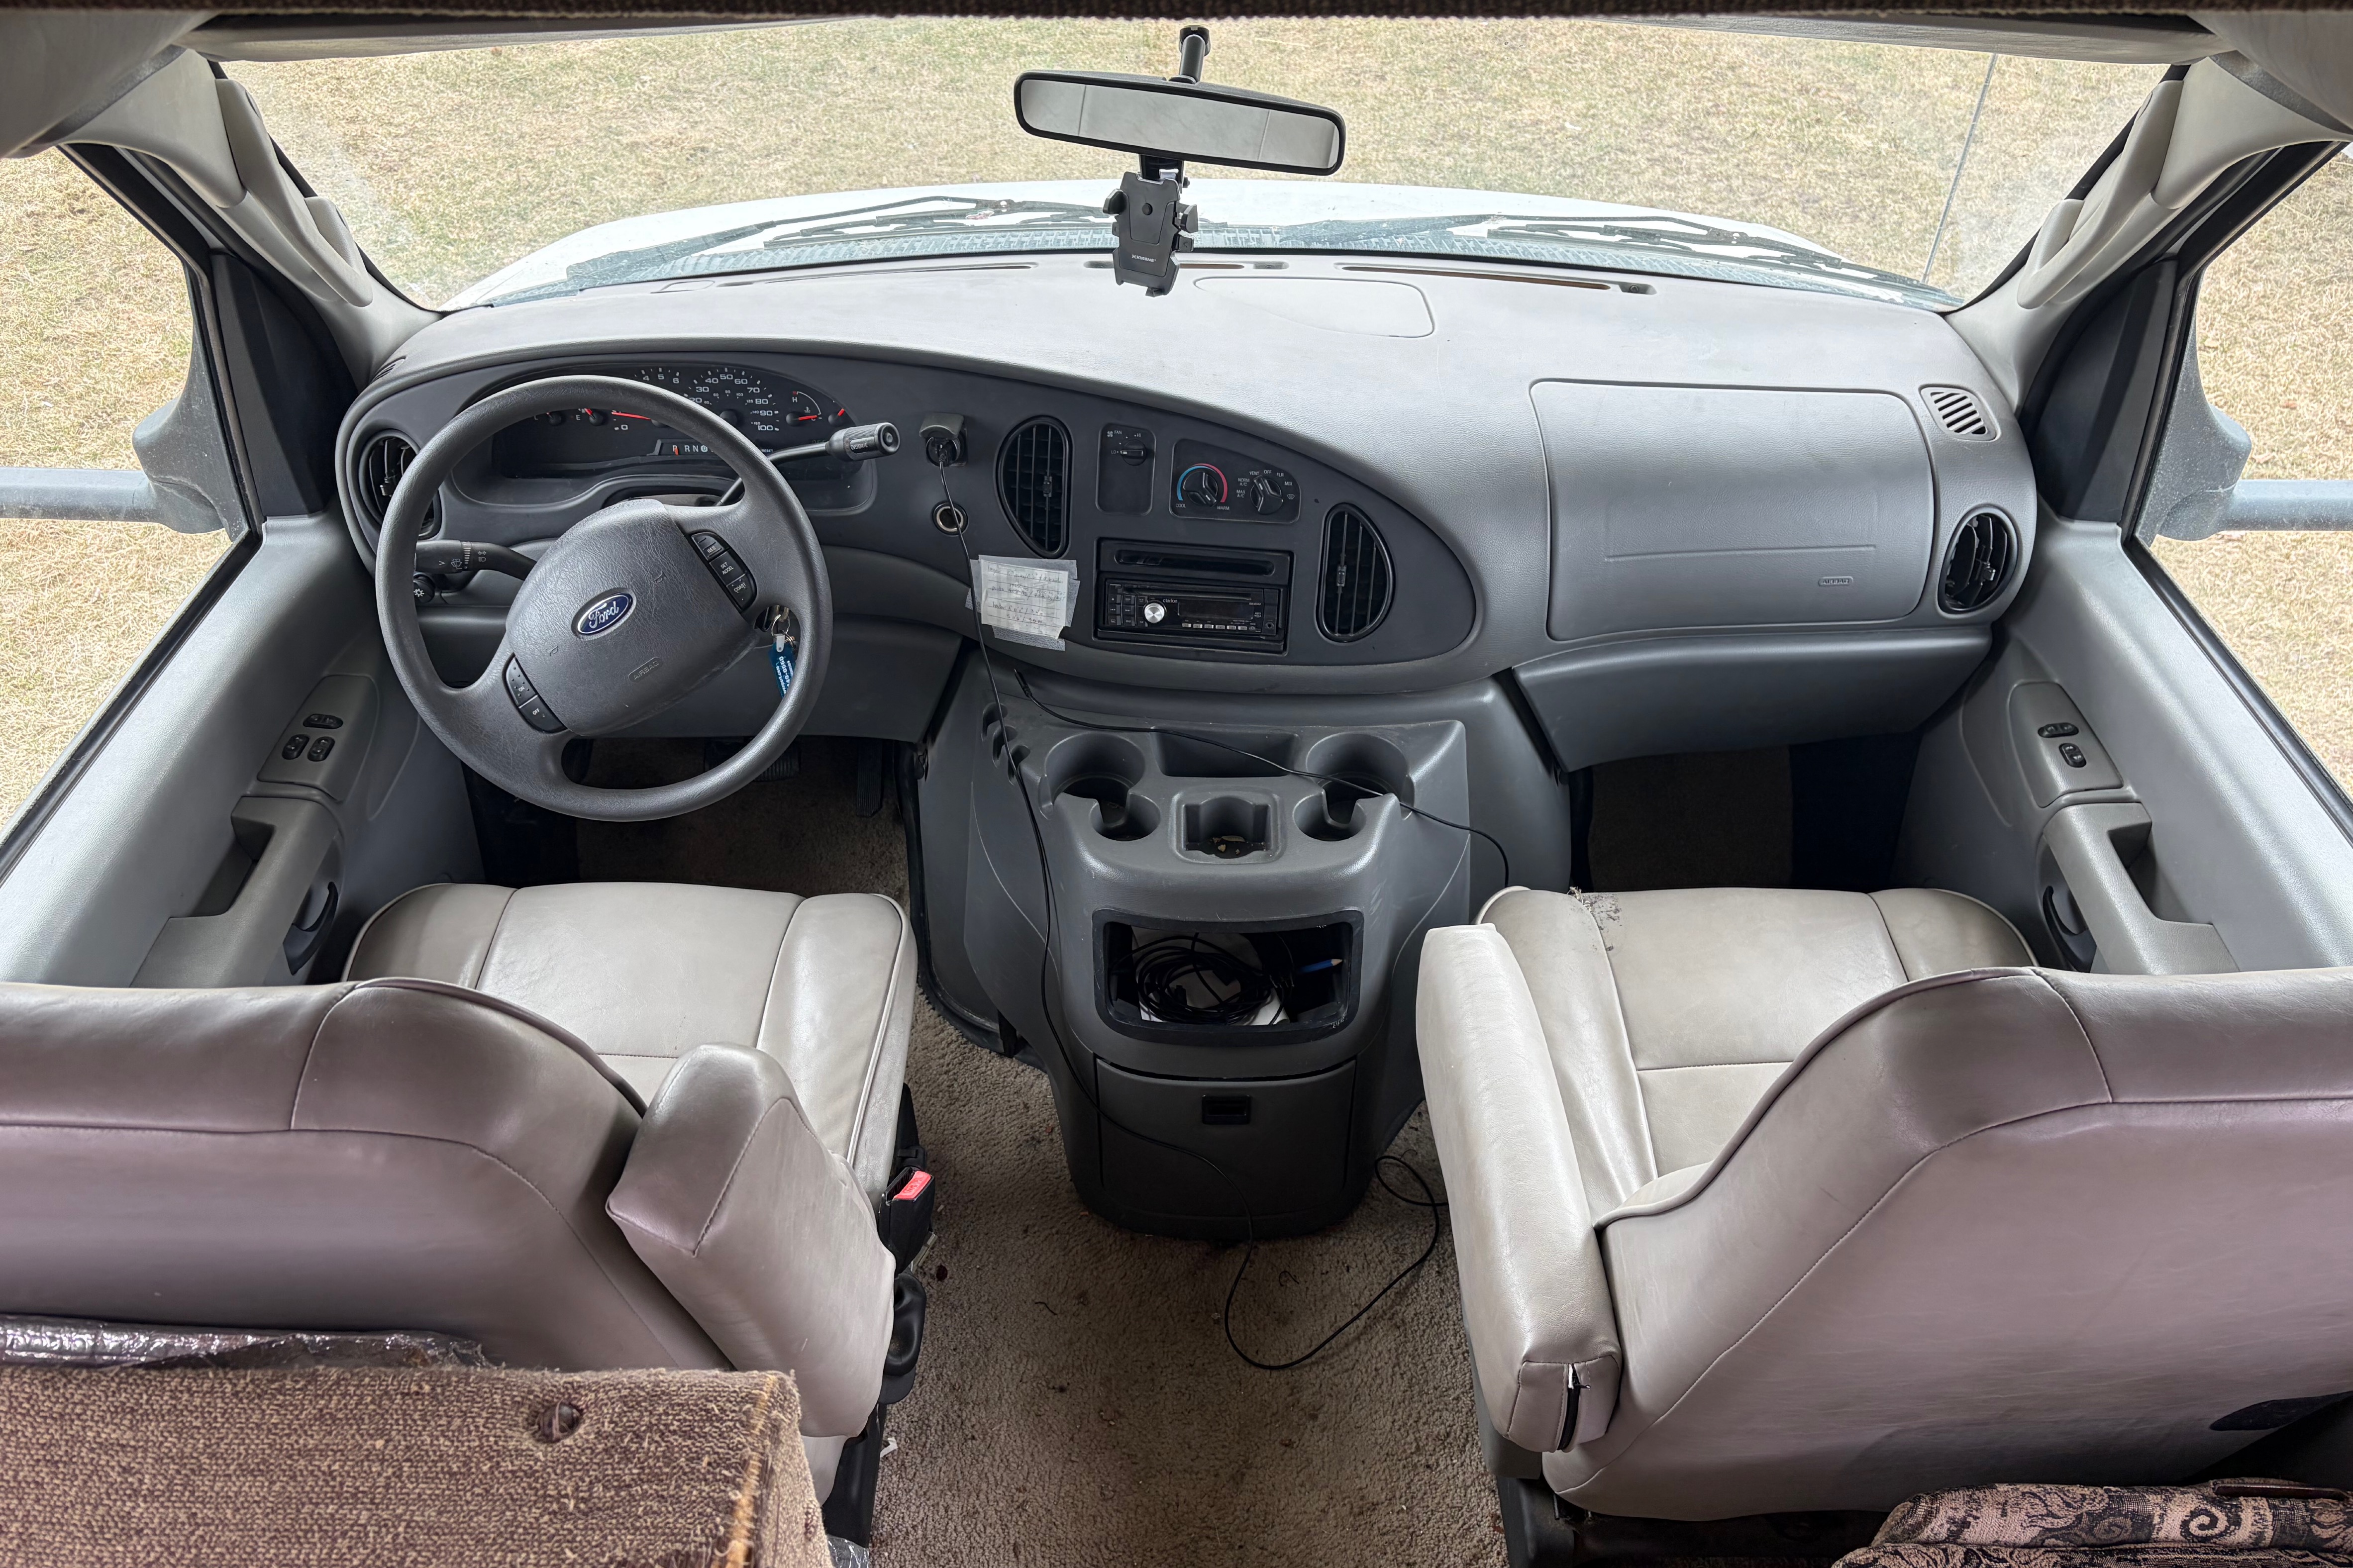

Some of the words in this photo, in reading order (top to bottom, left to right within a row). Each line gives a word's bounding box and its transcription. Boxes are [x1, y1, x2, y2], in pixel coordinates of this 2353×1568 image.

[734, 582, 746, 592] COAST
[589, 601, 619, 629] Ford
[633, 660, 659, 680] AIRBAG
